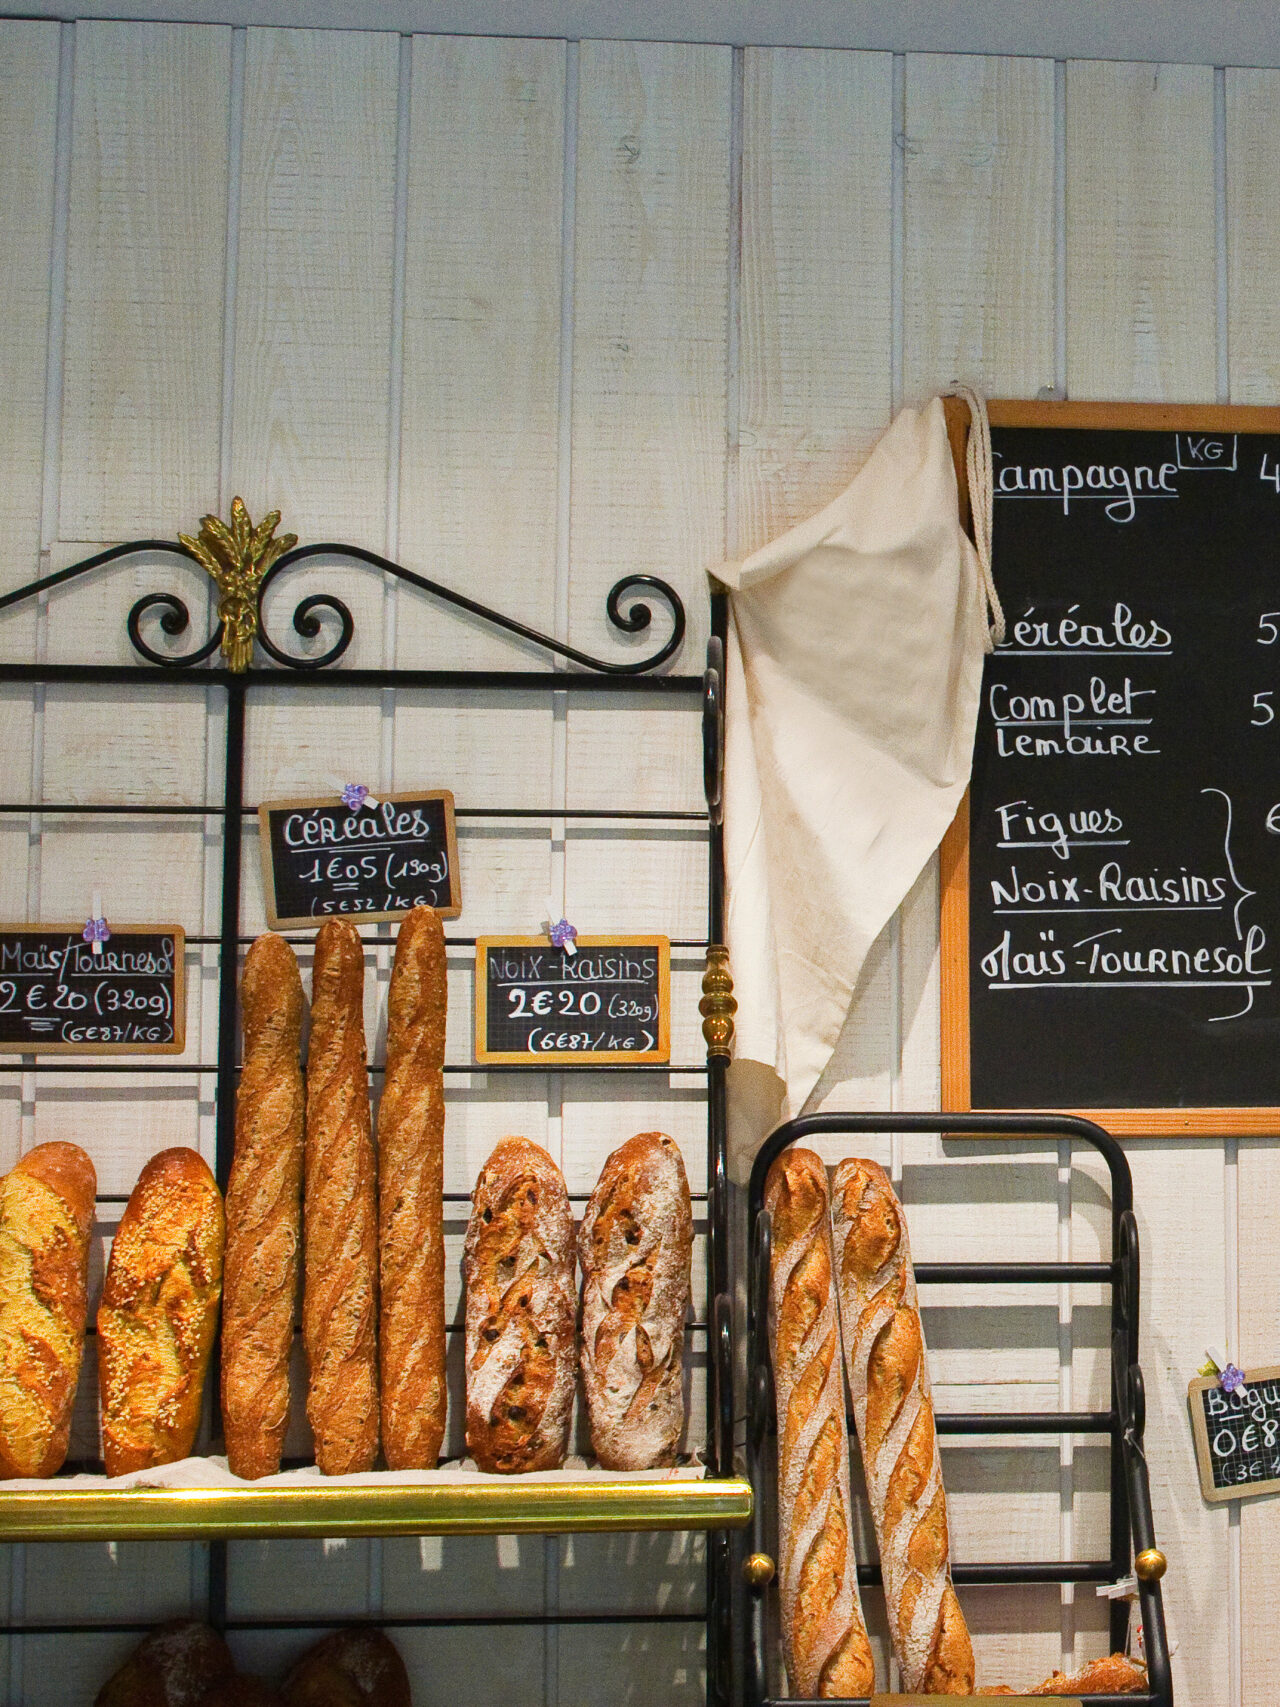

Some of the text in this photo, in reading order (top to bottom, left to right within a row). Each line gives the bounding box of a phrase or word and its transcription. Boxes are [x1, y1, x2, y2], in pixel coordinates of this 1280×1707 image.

[1188, 437, 1225, 461] KG
[997, 603, 1173, 648] éréales
[990, 677, 1156, 739] Complet
[995, 800, 1123, 859] Figues
[299, 851, 448, 889] 1€05 (190g)
[0, 981, 172, 1019] 2€20 (320g)
[508, 989, 659, 1022] 2€20 (320g)
